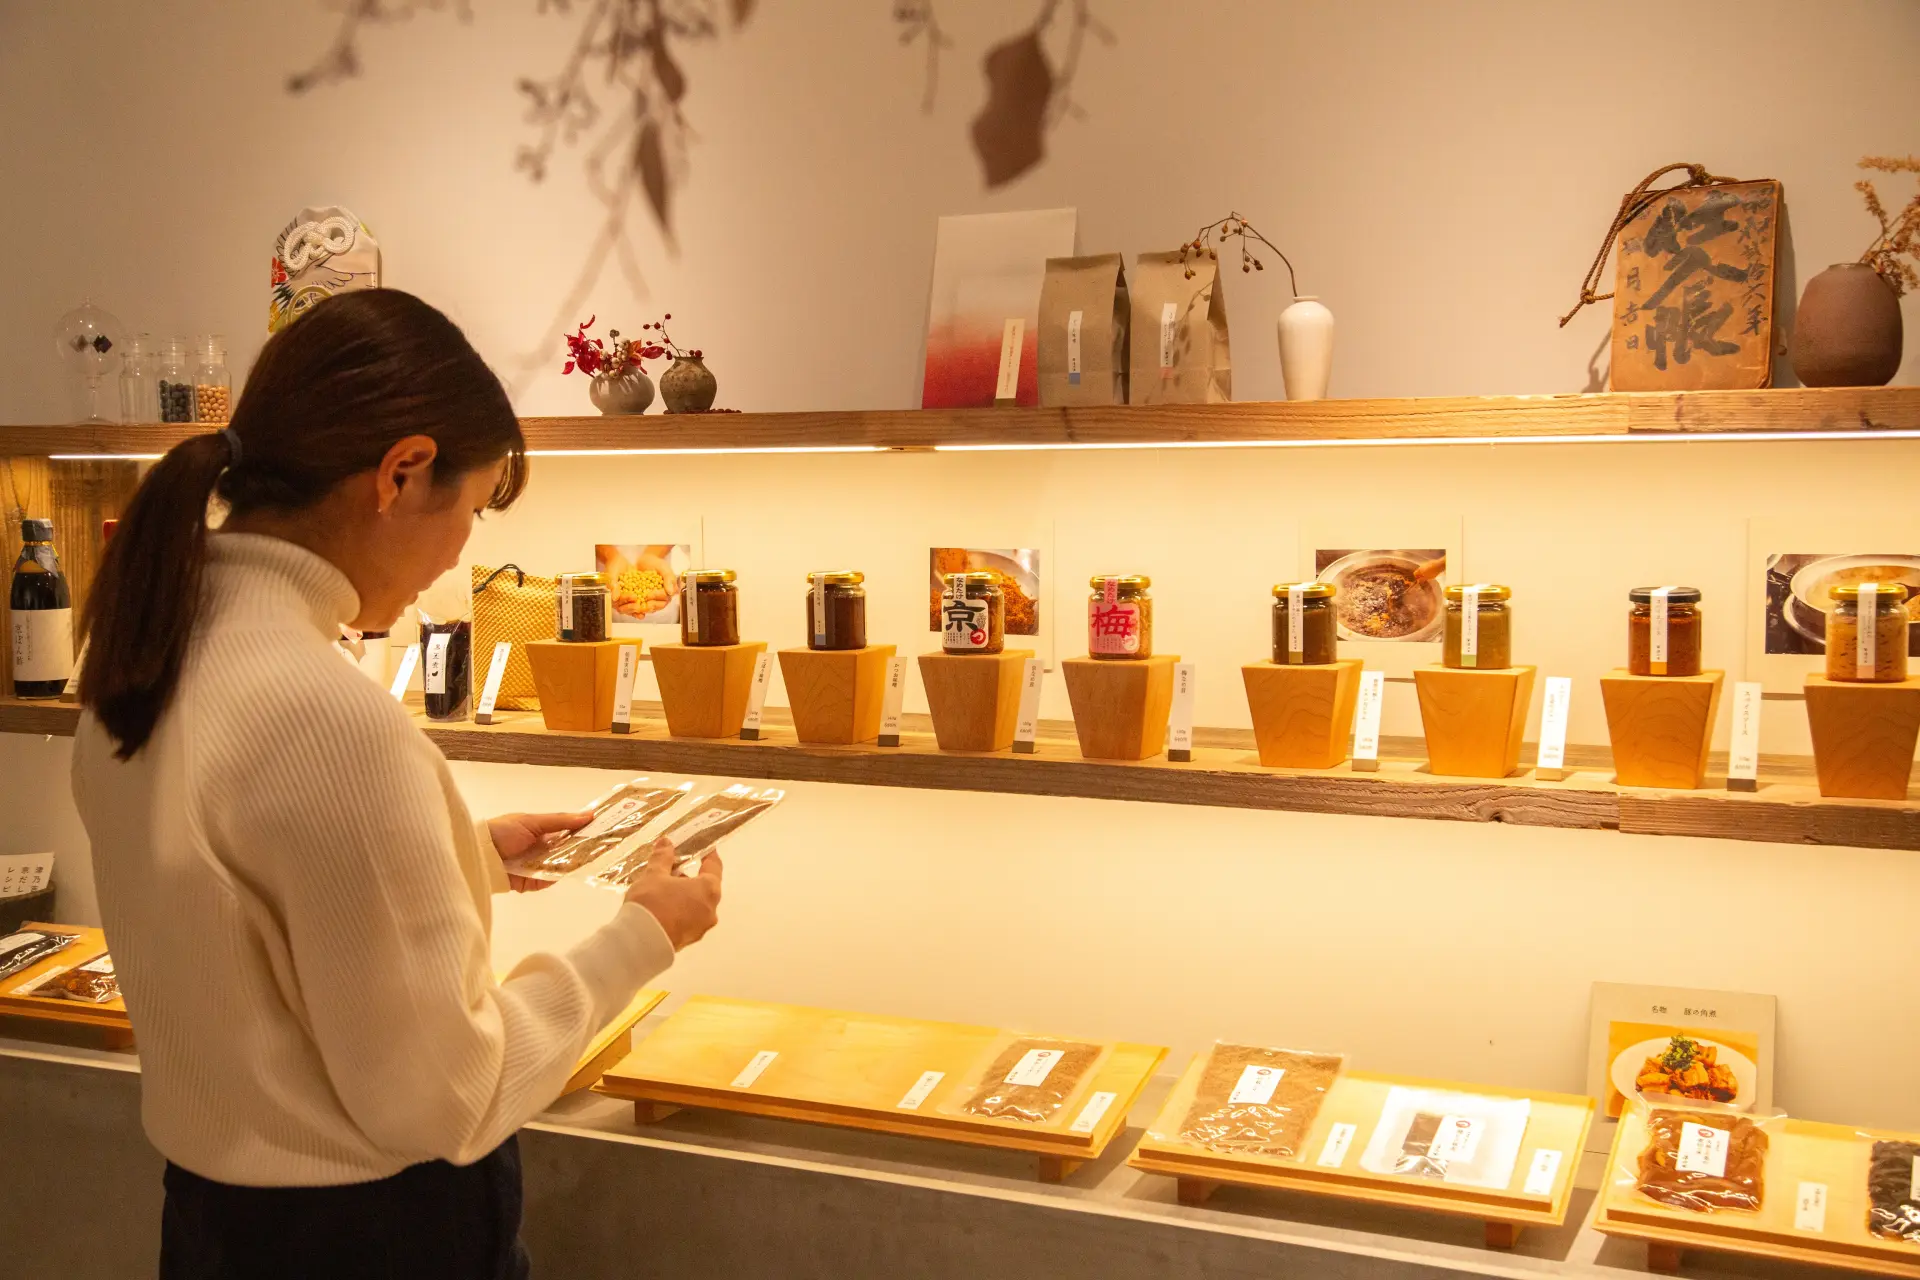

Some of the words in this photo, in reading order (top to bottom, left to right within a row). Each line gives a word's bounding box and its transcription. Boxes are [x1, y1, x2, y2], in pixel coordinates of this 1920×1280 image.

[956, 577, 964, 600] なめたけ
[943, 600, 986, 633] 京
[1091, 604, 1135, 639] 梅
[1651, 1005, 1667, 1014] 名物
[1683, 1007, 1717, 1018] 豚の角煮
